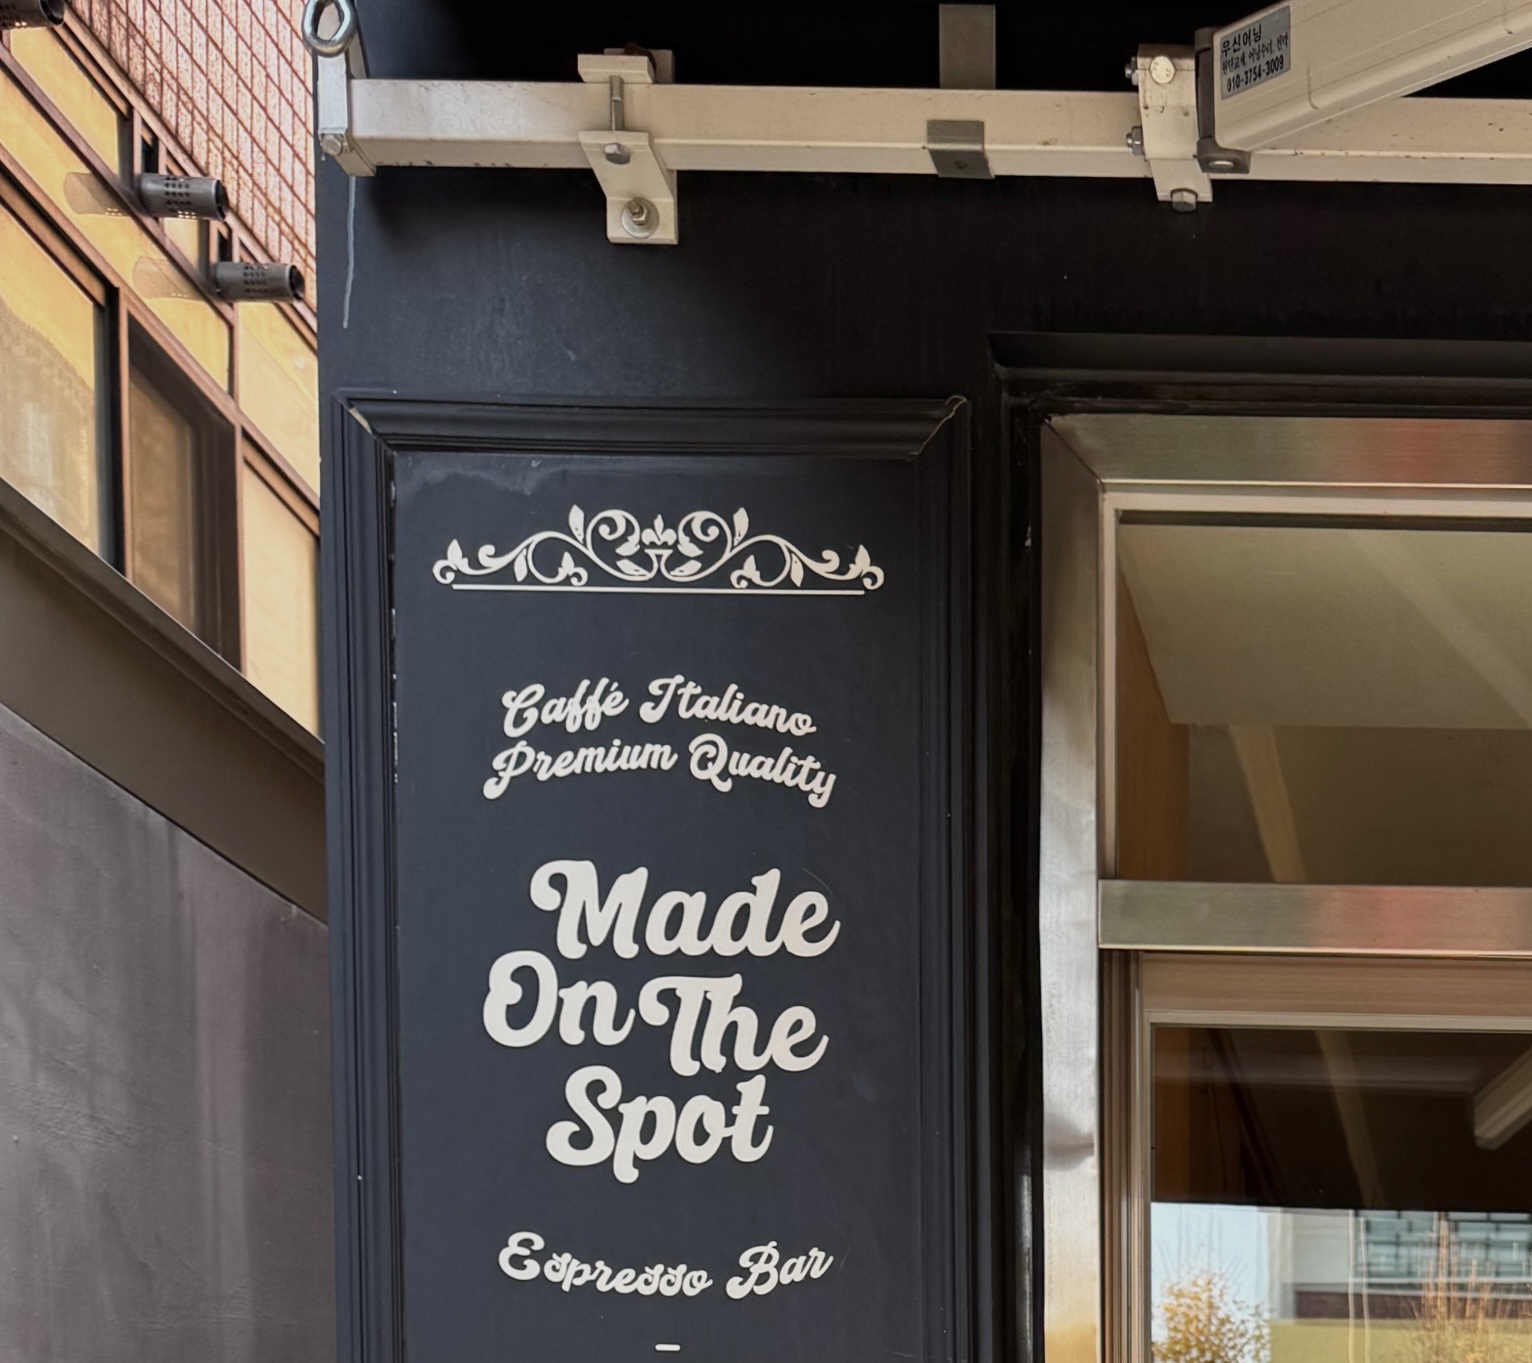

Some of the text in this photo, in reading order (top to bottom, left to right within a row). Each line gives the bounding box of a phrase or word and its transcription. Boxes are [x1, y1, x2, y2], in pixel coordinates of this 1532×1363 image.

[1222, 24, 1262, 57] 우신어닝
[502, 675, 817, 738] Caffé Italiano
[483, 734, 837, 808] Premium Quality
[530, 860, 841, 959] Made
[483, 951, 830, 1077] On The
[546, 1065, 774, 1183] Spot
[498, 1231, 834, 1299] Espresso Bar
